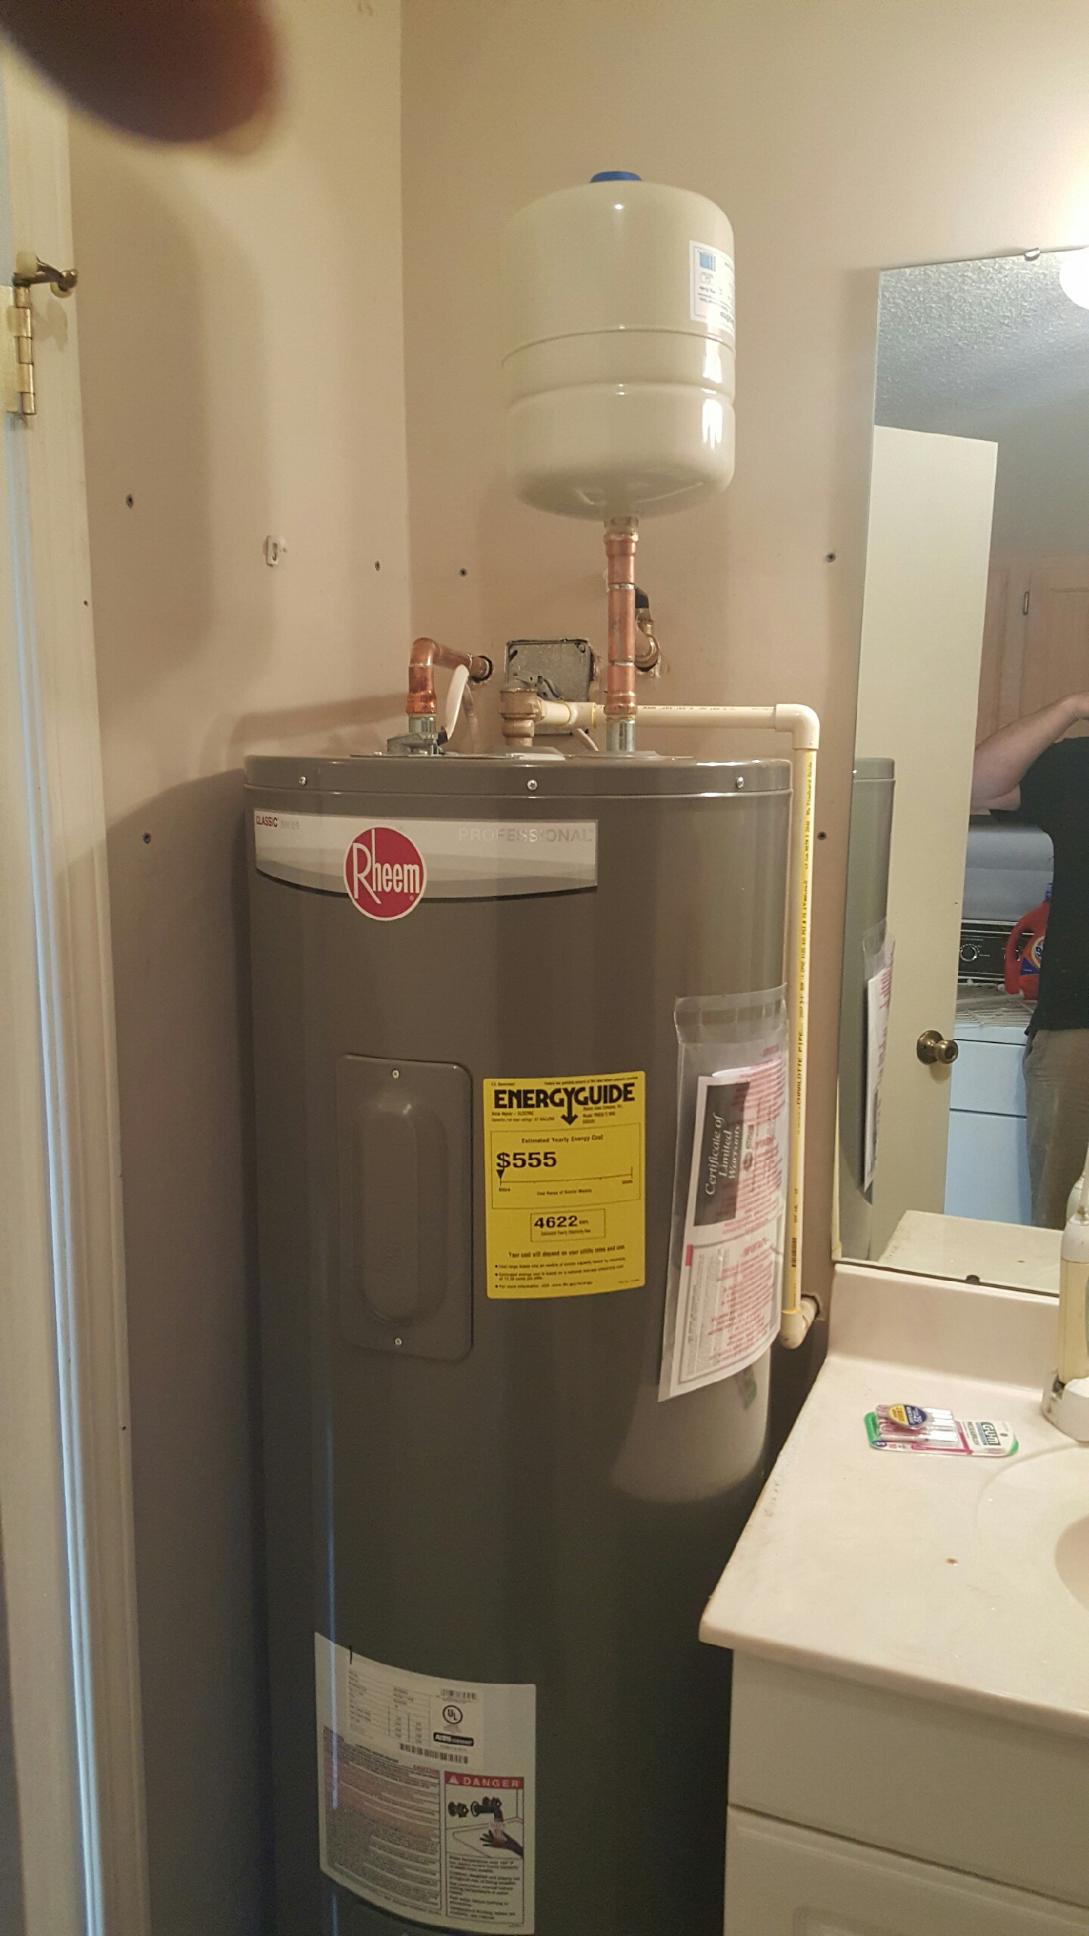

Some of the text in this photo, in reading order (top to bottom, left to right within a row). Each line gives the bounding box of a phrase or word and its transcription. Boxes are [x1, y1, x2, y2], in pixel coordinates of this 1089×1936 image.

[255, 815, 278, 828] CLASSIC
[457, 828, 593, 843] PROFESSIONAL
[352, 829, 420, 904] Rheem
[493, 1083, 636, 1110] ENERGYGUIDE
[521, 1133, 604, 1144] Estimated Yearly Energy Cost
[496, 1151, 557, 1170] $555
[704, 1112, 726, 1196] Certificate of
[718, 1129, 733, 1177] Limited
[726, 1123, 741, 1180] Warranty
[534, 1215, 578, 1229] 4622
[463, 1777, 521, 1789] DANGER
